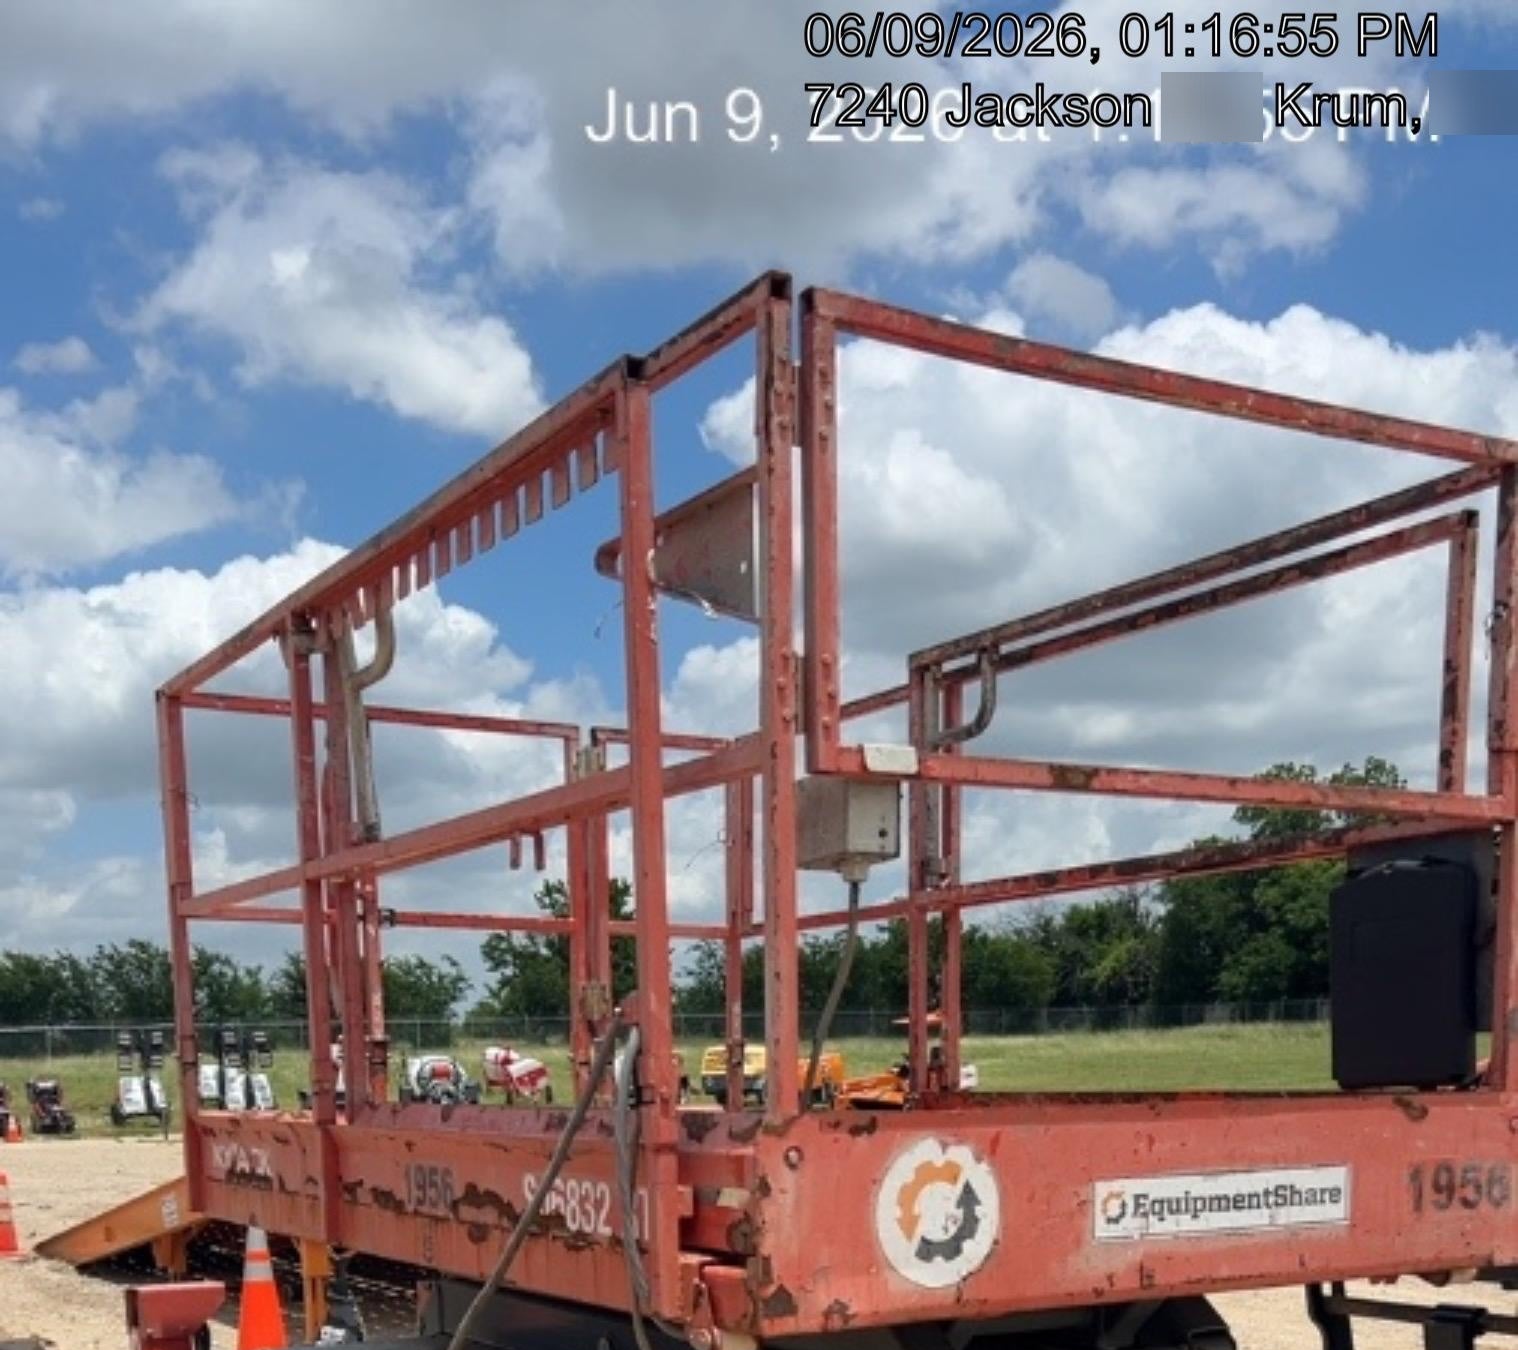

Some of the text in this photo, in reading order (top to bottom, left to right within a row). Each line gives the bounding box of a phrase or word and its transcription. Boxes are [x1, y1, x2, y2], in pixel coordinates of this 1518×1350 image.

[405, 1162, 454, 1210] 1956
[1131, 1184, 1342, 1220] EquipmentShare
[1408, 1161, 1511, 1213] 1956
